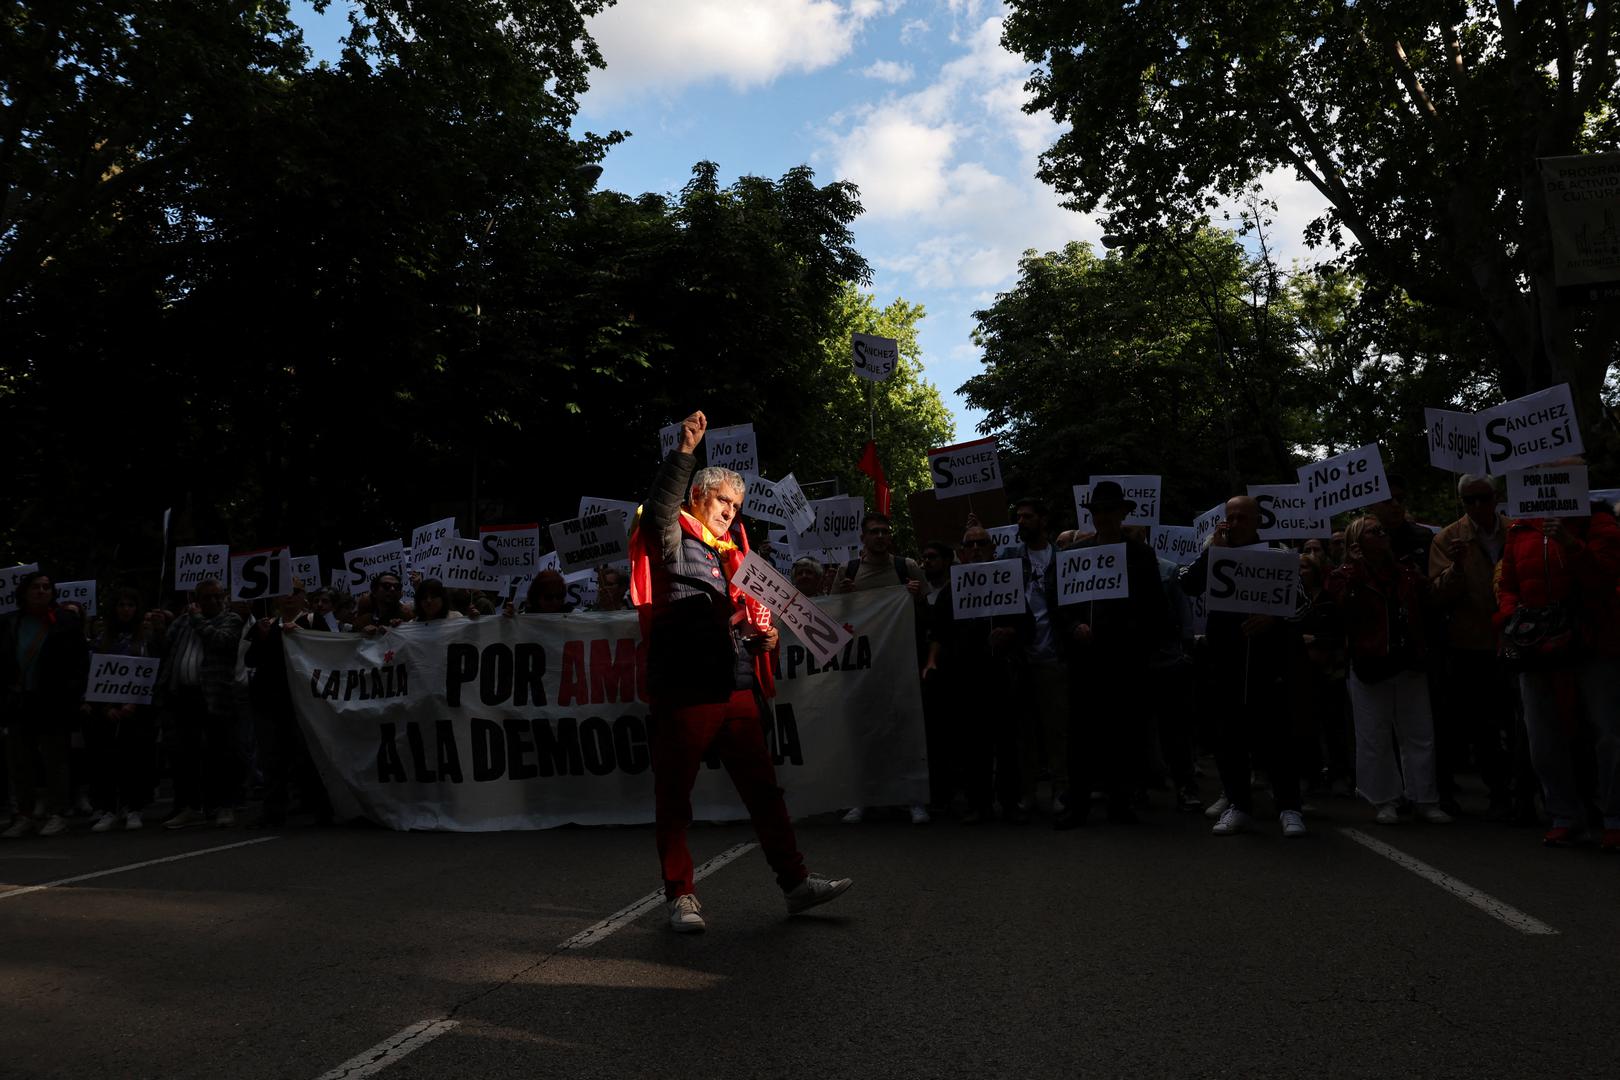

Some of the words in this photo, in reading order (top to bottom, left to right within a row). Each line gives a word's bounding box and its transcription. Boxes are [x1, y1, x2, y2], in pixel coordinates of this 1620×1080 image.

[712, 443, 732, 460] ¡No
[736, 441, 748, 454] te
[1448, 427, 1480, 460] sigue!
[1309, 467, 1341, 493] ¡No
[1347, 459, 1368, 476] te
[1523, 475, 1543, 486] POR
[1543, 473, 1570, 485] AMOR
[748, 482, 773, 499] ¡No
[1314, 475, 1380, 510] rindas!
[1546, 487, 1557, 498] LA
[1519, 500, 1578, 513] DEMOCRACIA
[563, 518, 583, 536] POR
[582, 513, 608, 531] AMOR
[824, 510, 860, 537] sigue!
[1196, 519, 1209, 539] ¡No
[414, 532, 431, 550] ¡No
[435, 527, 446, 540] te
[180, 553, 202, 569] ¡No
[207, 553, 219, 565] te
[446, 545, 475, 562] ¡No
[298, 563, 310, 573] te
[1062, 557, 1091, 578] ¡No
[1097, 554, 1115, 569] te
[957, 571, 987, 592] ¡No
[993, 570, 1011, 584] te
[1063, 573, 1122, 595] rindas!
[74, 588, 87, 598] te
[959, 589, 1018, 609] rindas!
[95, 662, 129, 677] ¡No
[135, 664, 153, 678] te
[446, 643, 548, 708] POR
[311, 668, 341, 700] LA
[343, 663, 409, 701] PLAZA
[377, 722, 408, 784] A
[406, 719, 464, 784] LA
